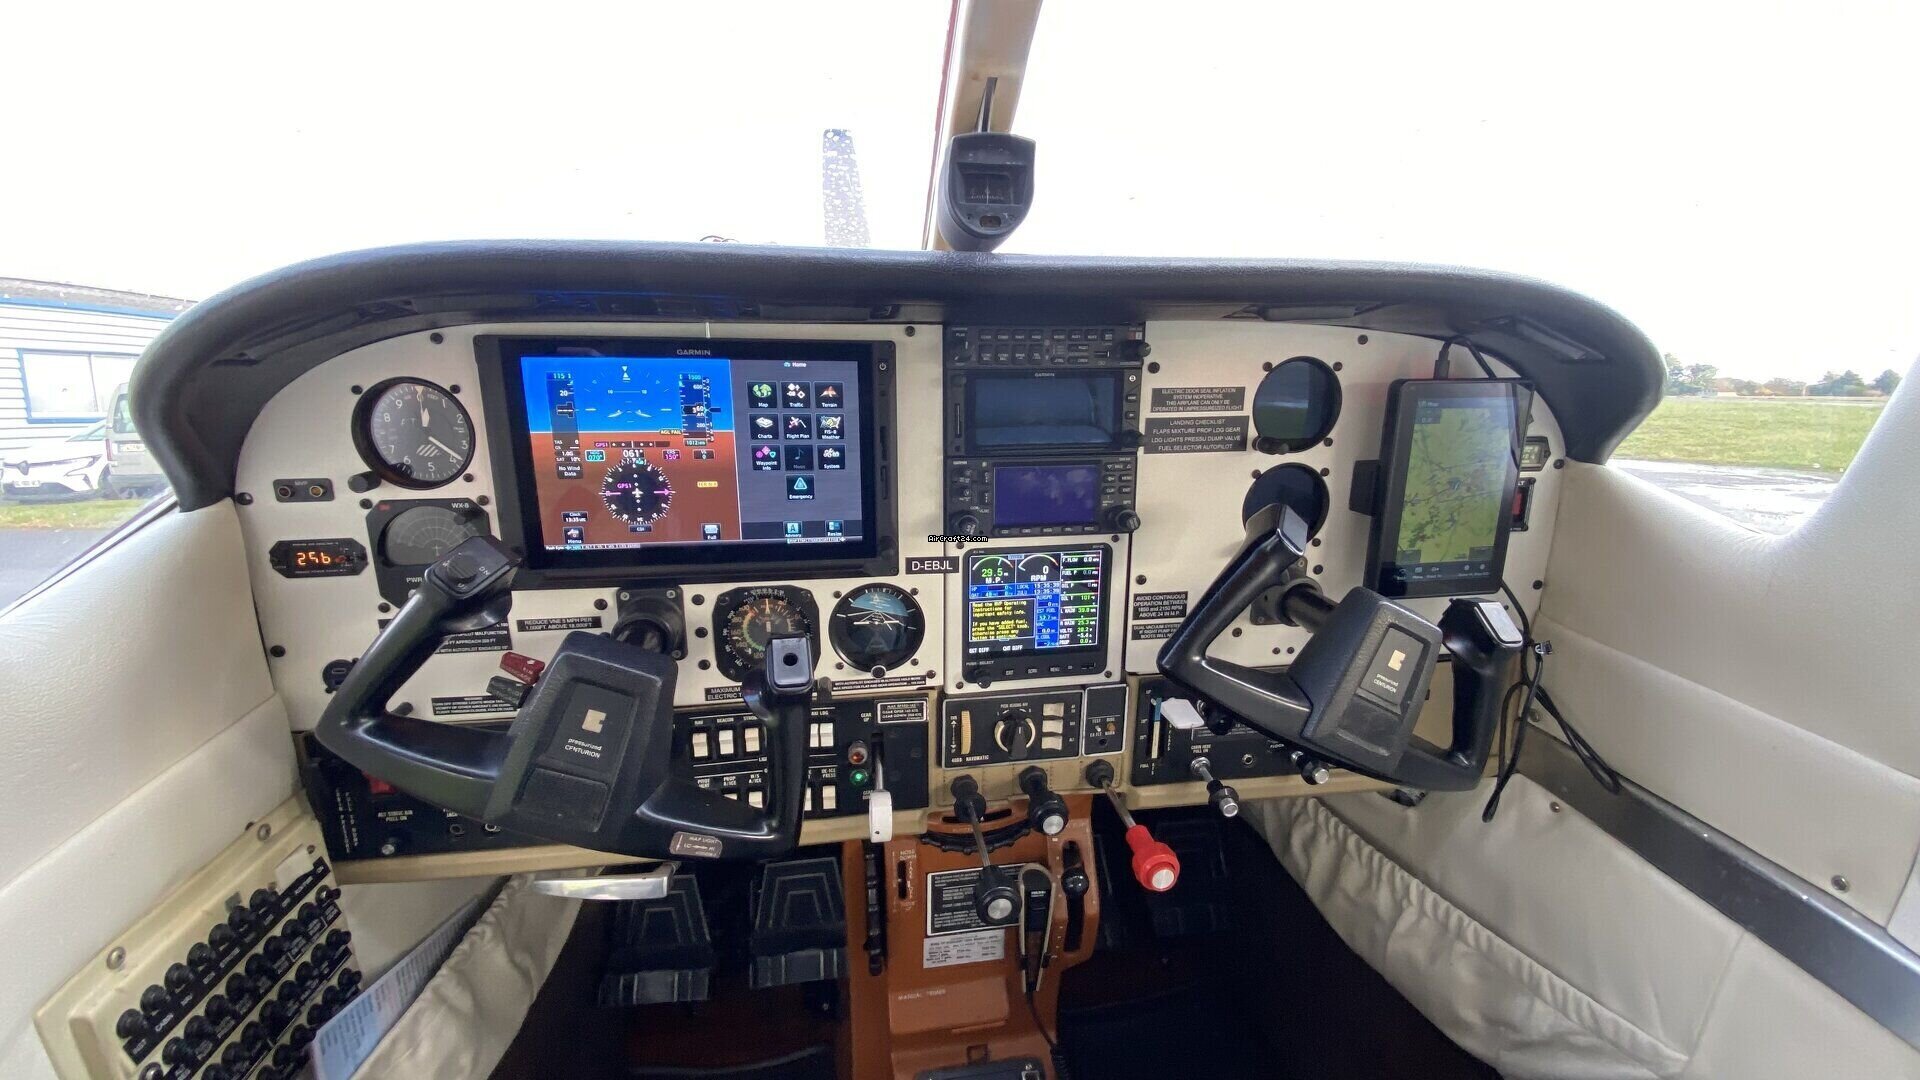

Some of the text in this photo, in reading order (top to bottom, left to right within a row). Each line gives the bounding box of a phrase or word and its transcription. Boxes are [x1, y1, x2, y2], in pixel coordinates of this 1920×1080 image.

[395, 400, 402, 408] 9
[384, 413, 391, 422] 8
[456, 414, 463, 424] 2
[389, 445, 395, 454] 7
[461, 440, 468, 450] 3
[403, 456, 411, 465] 6
[428, 462, 435, 472] 5
[912, 560, 953, 571] D-EBJL
[1042, 565, 1049, 574] 0
[982, 568, 1003, 577] 29.5
[1374, 679, 1396, 693] CENTURION
[568, 738, 602, 750] pressurized
[565, 745, 600, 758] CENTURION
